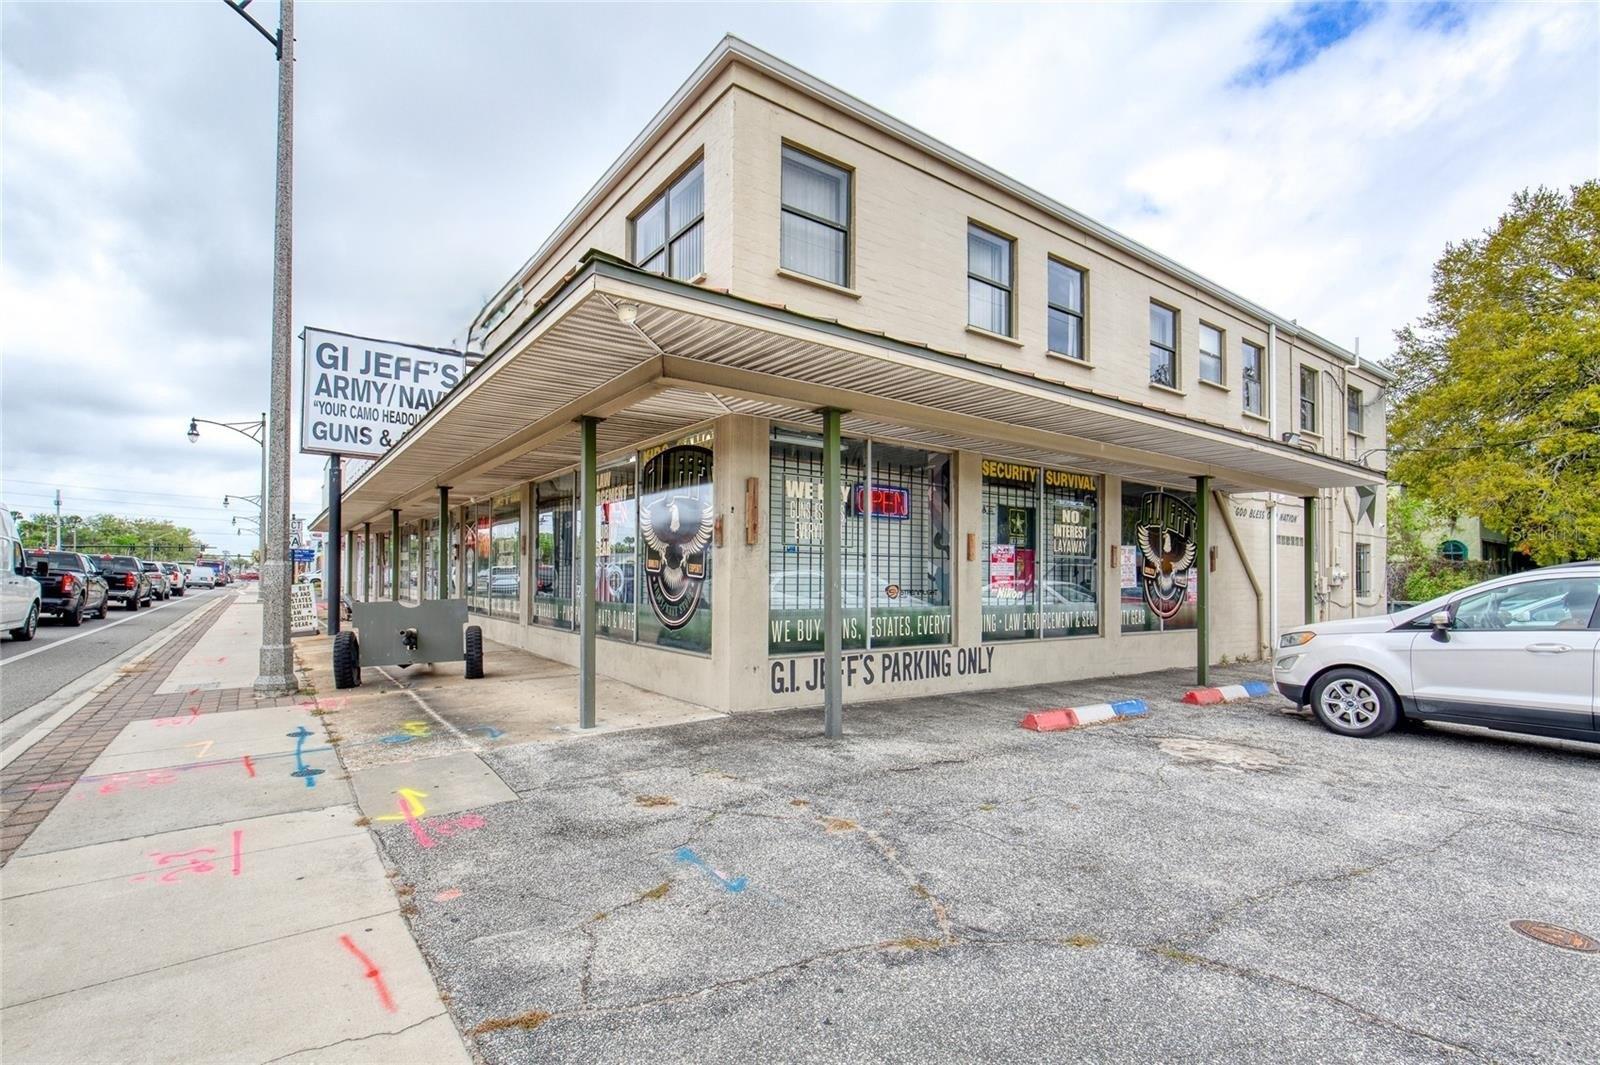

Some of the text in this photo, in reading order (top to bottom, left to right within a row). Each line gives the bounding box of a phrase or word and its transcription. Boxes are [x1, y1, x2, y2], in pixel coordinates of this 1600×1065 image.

[316, 342, 460, 389] GI JEFF'S
[314, 373, 449, 411] ARMY/NAV
[350, 405, 379, 421] CAMO
[312, 421, 392, 447] GUNS &
[982, 460, 1096, 490] SECURITY SURVIVAL
[785, 480, 813, 499] WE
[857, 489, 908, 516] OPEN
[1062, 509, 1080, 524] NO
[1249, 509, 1265, 519] BLESS
[1054, 523, 1087, 540] INTEREST
[1053, 538, 1088, 554] LAYAWAY
[997, 587, 1024, 600] Nikon
[771, 620, 791, 643] WE
[797, 618, 821, 642] BUY
[870, 615, 914, 637] ESTATES,
[1005, 613, 1020, 631] LAW
[1131, 609, 1146, 625] GEAR
[771, 660, 800, 694] G.I.
[882, 648, 951, 683] PARKING
[957, 647, 995, 675] ONLY
